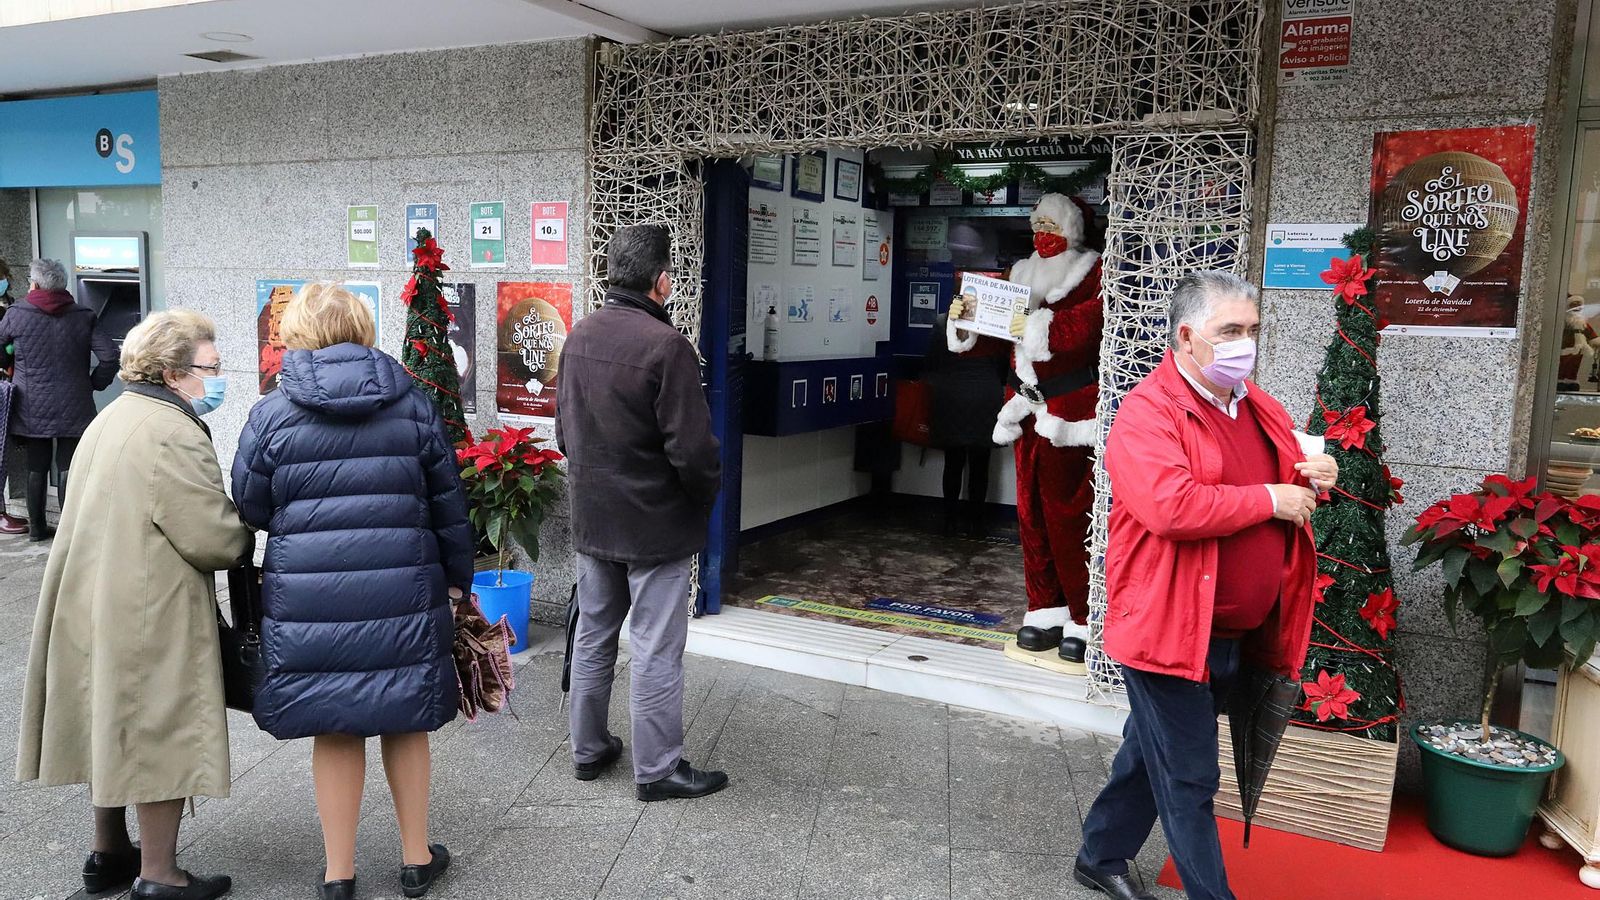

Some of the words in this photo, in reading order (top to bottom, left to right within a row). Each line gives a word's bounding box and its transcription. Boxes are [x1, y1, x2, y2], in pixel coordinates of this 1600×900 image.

[1284, 23, 1349, 37] Alarma
[1313, 36, 1348, 45] grabación
[1310, 44, 1348, 52] imágenes
[1282, 56, 1307, 64] Aviso
[1318, 53, 1347, 61] Policía
[100, 135, 109, 151] B
[116, 133, 135, 174] S
[957, 150, 975, 159] YA
[977, 149, 1004, 158] HAY
[1069, 144, 1088, 155] DE
[1425, 166, 1464, 192] EL
[1402, 184, 1492, 221] SORTEO
[480, 206, 493, 215] BOTE
[542, 206, 556, 215] BOTE
[1423, 213, 1452, 229] QUE
[1456, 205, 1488, 229] NOS
[482, 226, 491, 234] 21
[1413, 227, 1470, 261] UNE
[990, 281, 999, 289] DE
[999, 283, 1029, 296] NAVIDAD
[981, 293, 1012, 306] 09721
[1441, 298, 1473, 306] Navidad
[512, 321, 555, 344] SORTEO
[523, 339, 537, 350] QUE
[538, 334, 554, 351] NOS
[519, 348, 547, 372] UNE
[889, 601, 922, 611] POR
[876, 615, 931, 628] DISTANCIA
